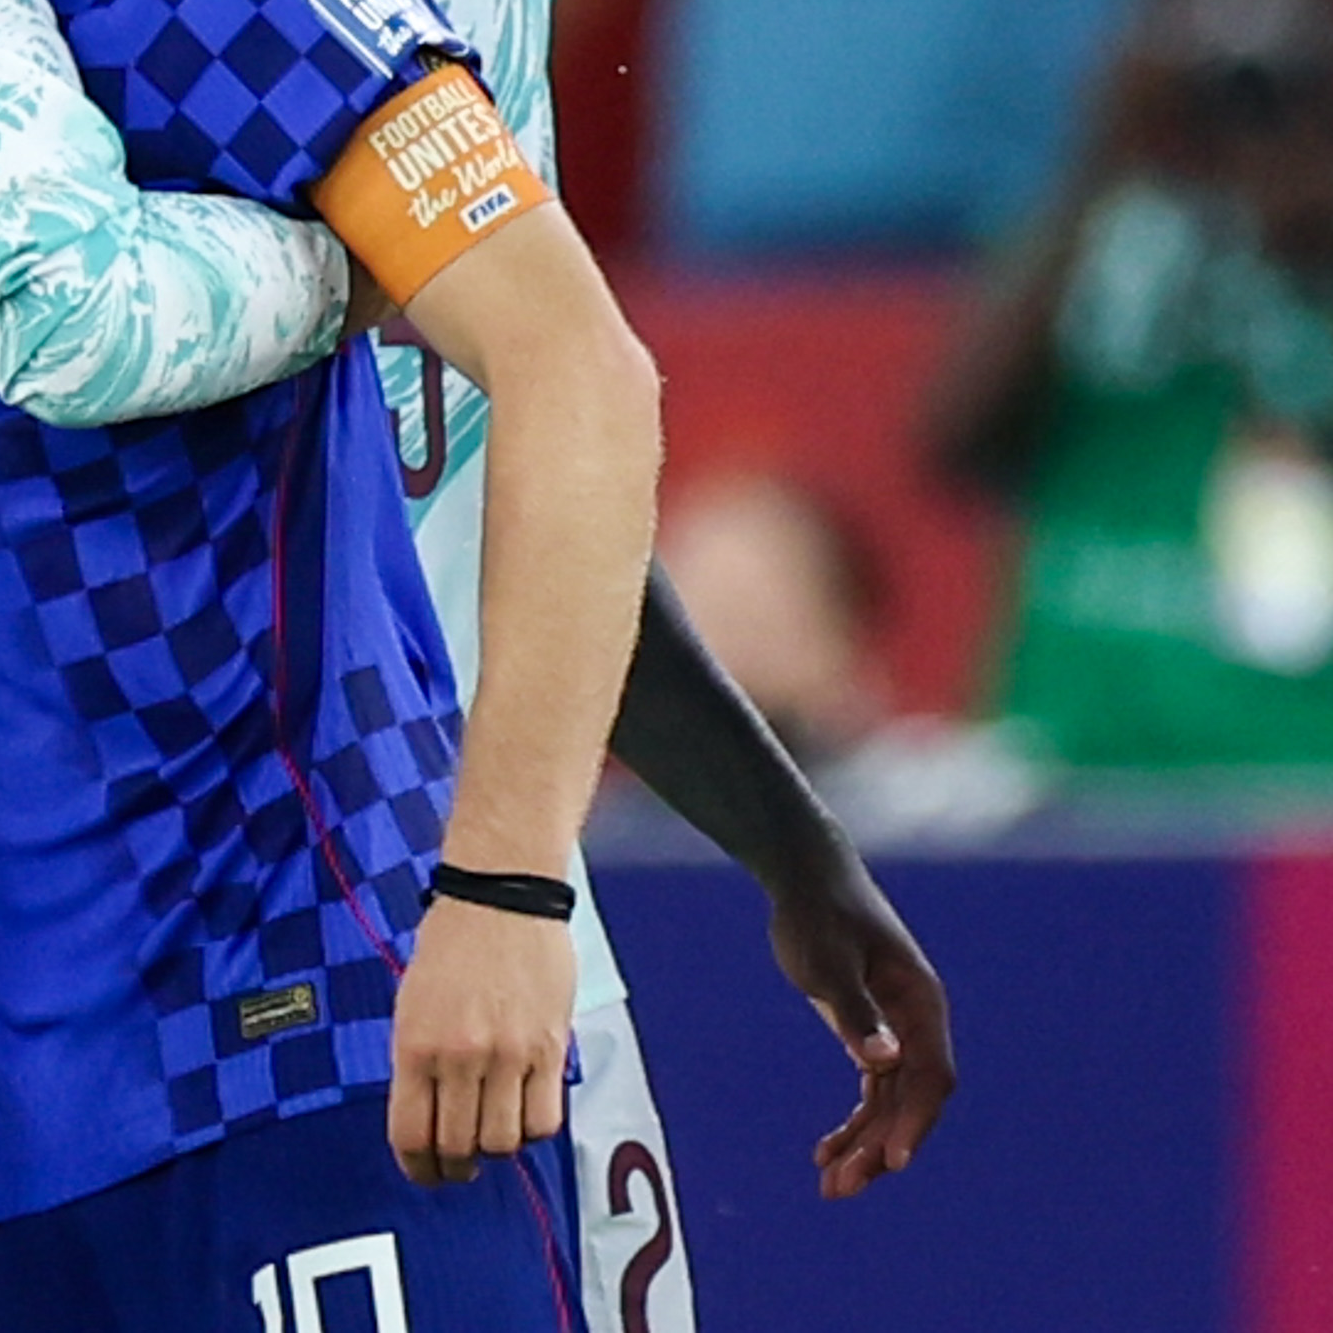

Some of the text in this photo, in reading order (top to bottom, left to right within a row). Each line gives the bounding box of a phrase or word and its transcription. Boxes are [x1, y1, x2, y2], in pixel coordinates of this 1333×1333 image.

[368, 77, 479, 161] FOOTBALL
[386, 102, 502, 192] UNITES
[406, 186, 458, 229] the
[467, 191, 511, 224] FIFA
